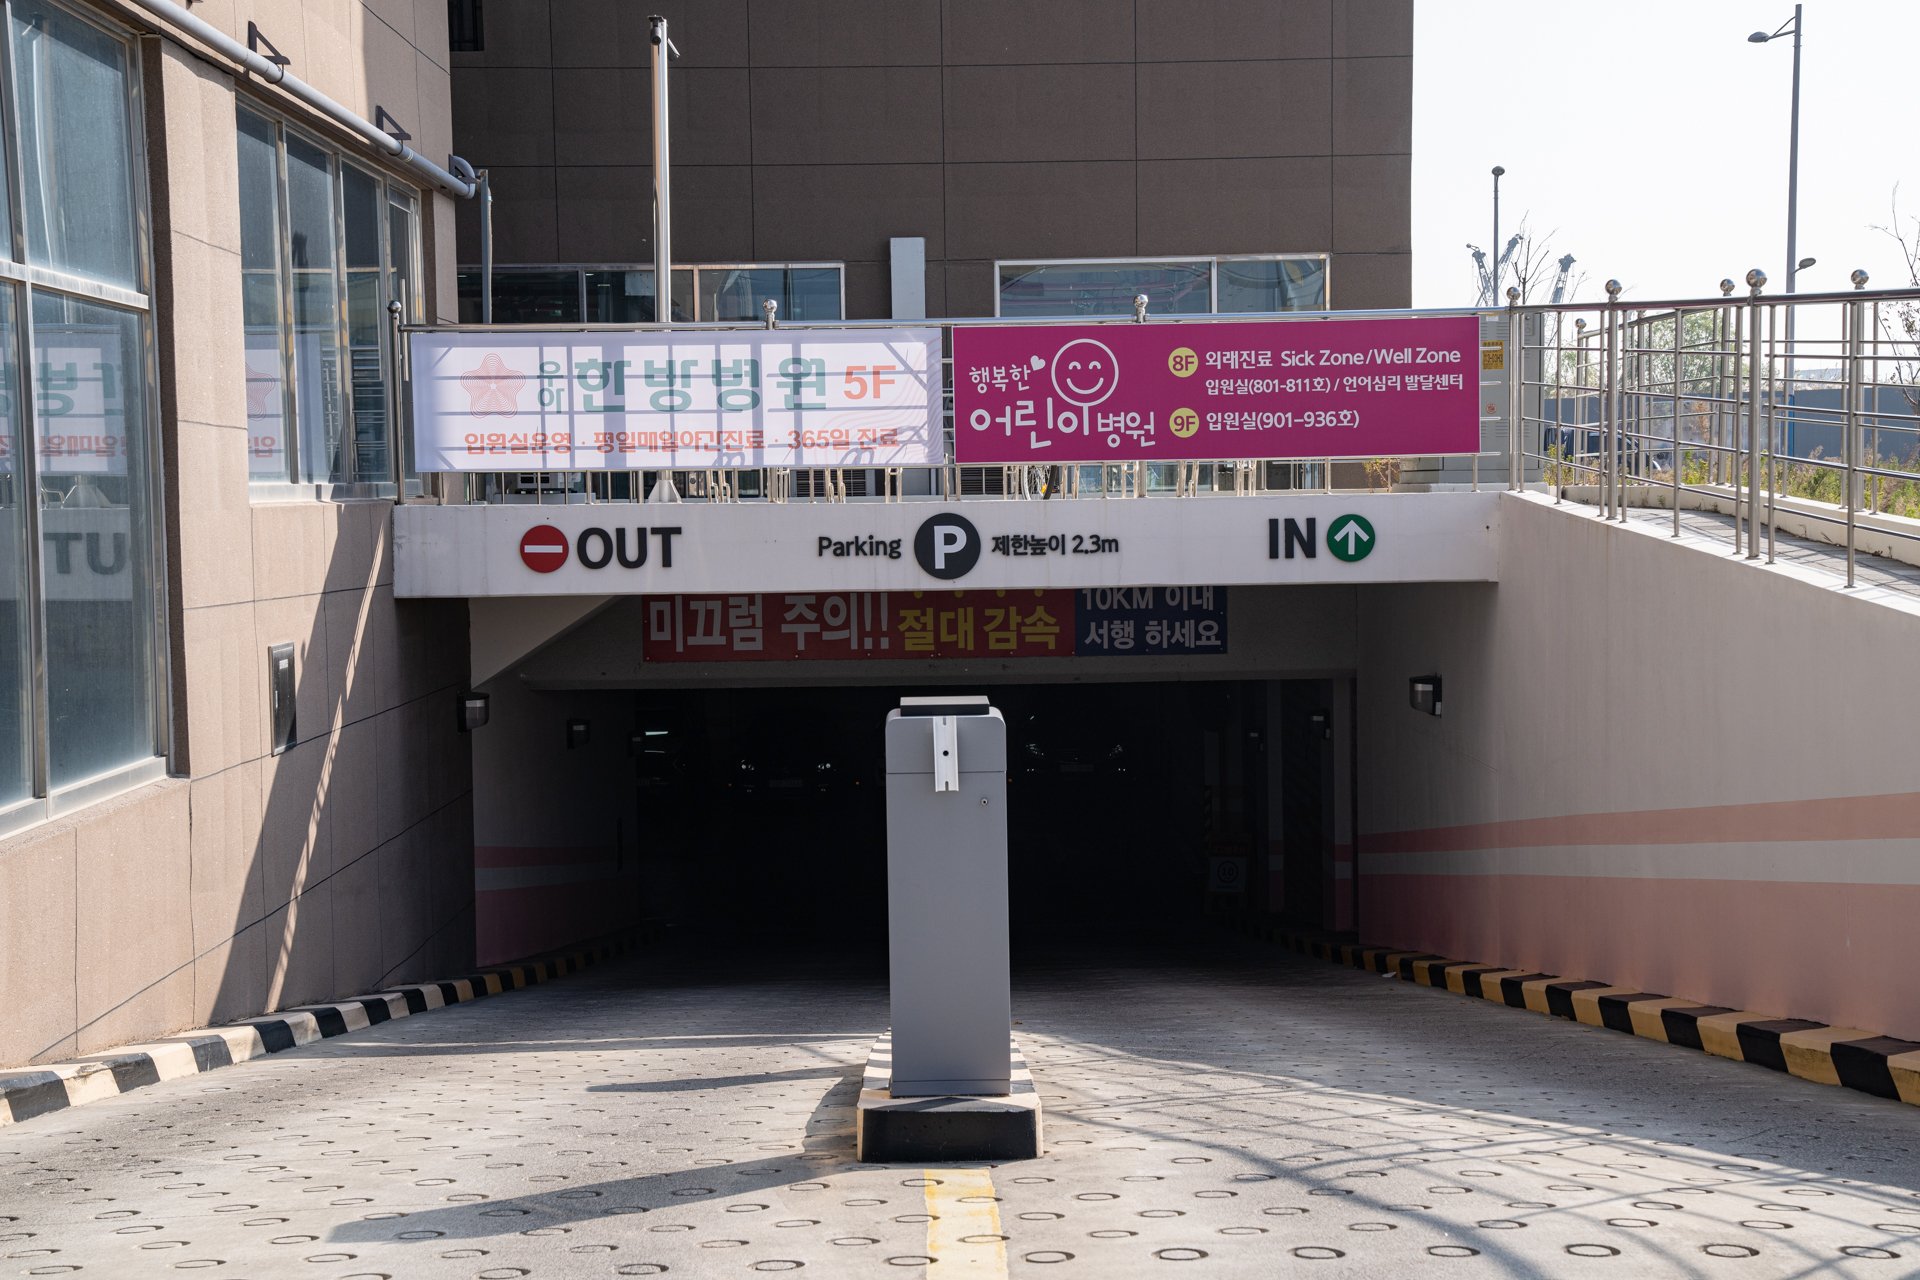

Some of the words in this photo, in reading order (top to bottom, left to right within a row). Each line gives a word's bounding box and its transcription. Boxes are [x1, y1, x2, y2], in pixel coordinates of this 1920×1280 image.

[1172, 355, 1194, 372] 8F
[1206, 351, 1272, 370] 외래진료
[1281, 350, 1315, 367] Sick
[1416, 348, 1461, 364] Zone
[843, 365, 897, 400] 5F
[969, 364, 1031, 394] 행복한
[1206, 377, 1331, 396] 입원실(801-811호)
[1343, 376, 1401, 393] 언어심리
[1405, 374, 1463, 391] 발달센터
[1174, 416, 1196, 432] 9F
[464, 432, 572, 455] 입원실운영
[787, 428, 850, 452] 365일
[857, 427, 900, 450] 진료
[577, 527, 682, 569] OUT
[818, 535, 902, 560] Parking
[933, 525, 967, 569] P
[991, 534, 1066, 557] 제한높이
[1071, 534, 1119, 556] 2.3m
[1268, 517, 1317, 559] IN
[1165, 586, 1214, 611] 이내
[649, 593, 763, 653] 미끄럼
[781, 592, 889, 651] 주의!!
[897, 606, 974, 651] 절대
[983, 605, 1060, 650] 감속
[1084, 619, 1135, 650] 서행
[1144, 619, 1222, 649] 하세요
